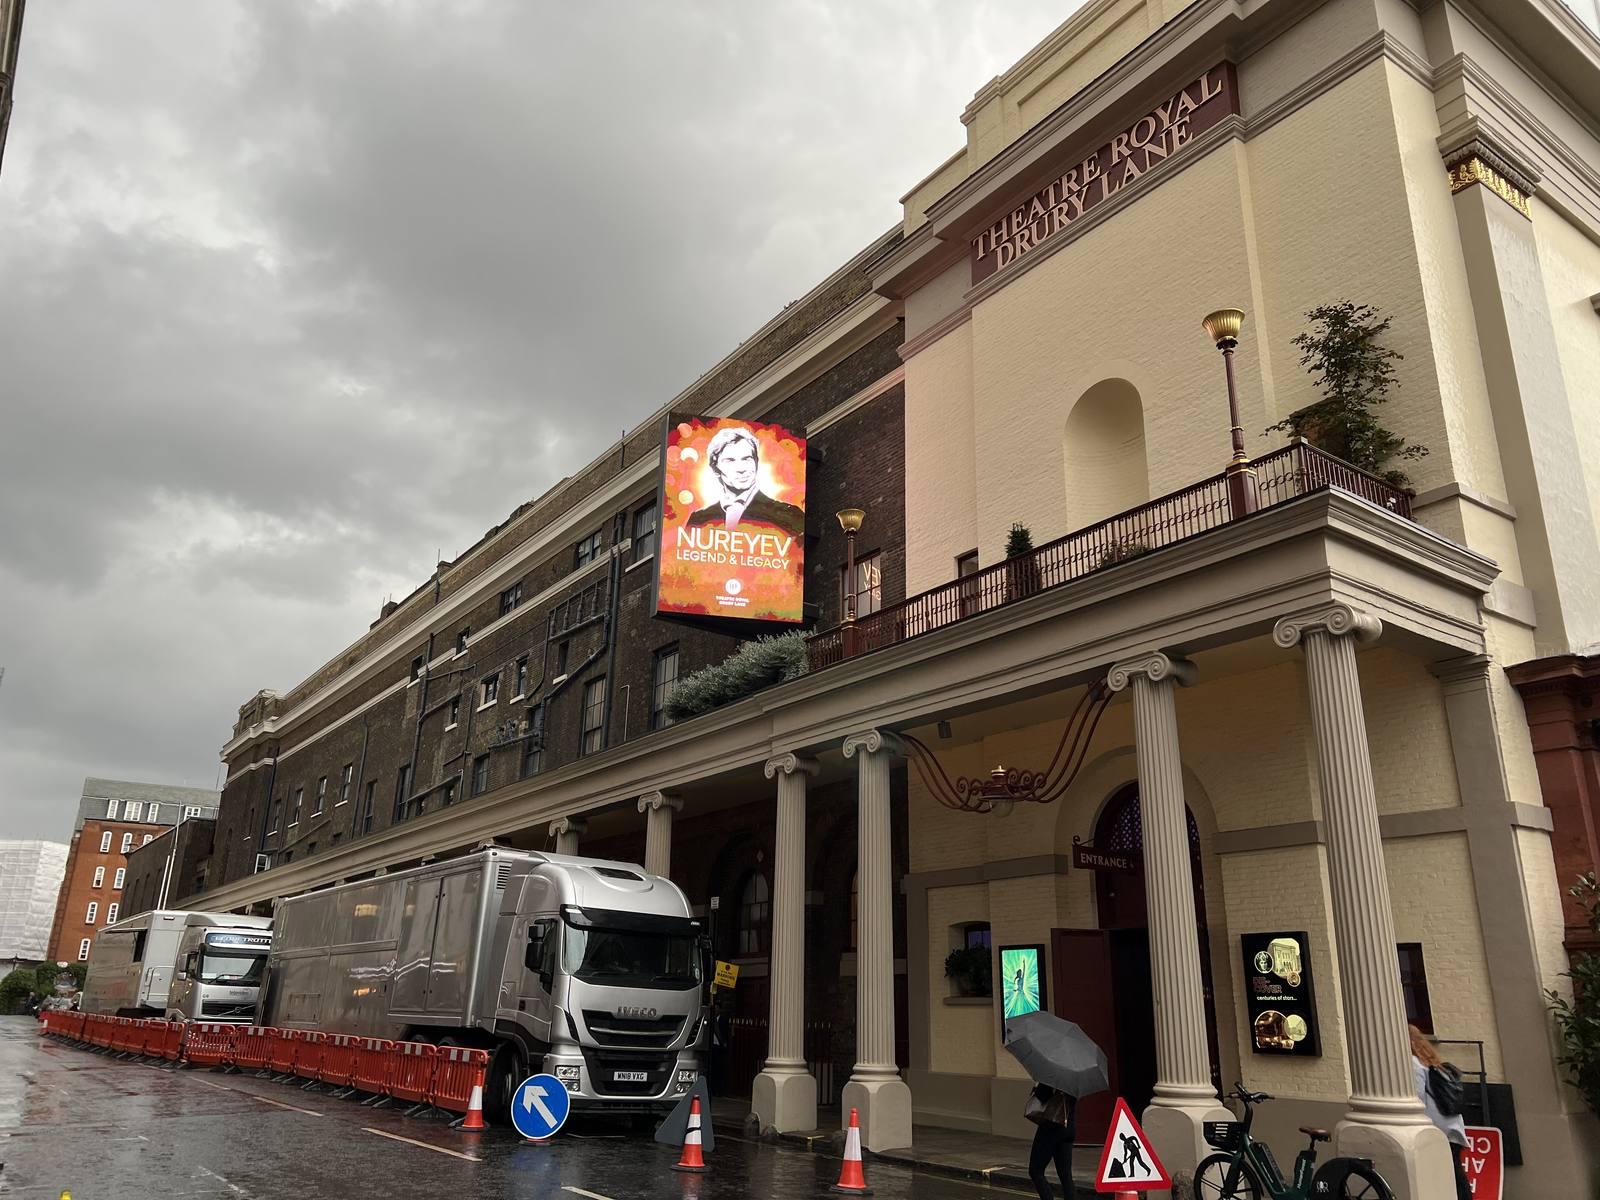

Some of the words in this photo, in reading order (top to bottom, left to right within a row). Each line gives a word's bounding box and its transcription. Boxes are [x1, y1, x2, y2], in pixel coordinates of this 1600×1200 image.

[972, 152, 1100, 261] THEATRE
[1110, 71, 1223, 167] ROYAL
[994, 186, 1090, 271] DRURY
[1099, 116, 1193, 200] LANE
[677, 526, 792, 557] NUREYEV
[676, 549, 726, 563] LEGEND
[729, 556, 737, 565] &
[740, 556, 790, 570] LEGACY
[1080, 852, 1127, 869] ENTRANCE
[617, 1006, 657, 1018] IVECO
